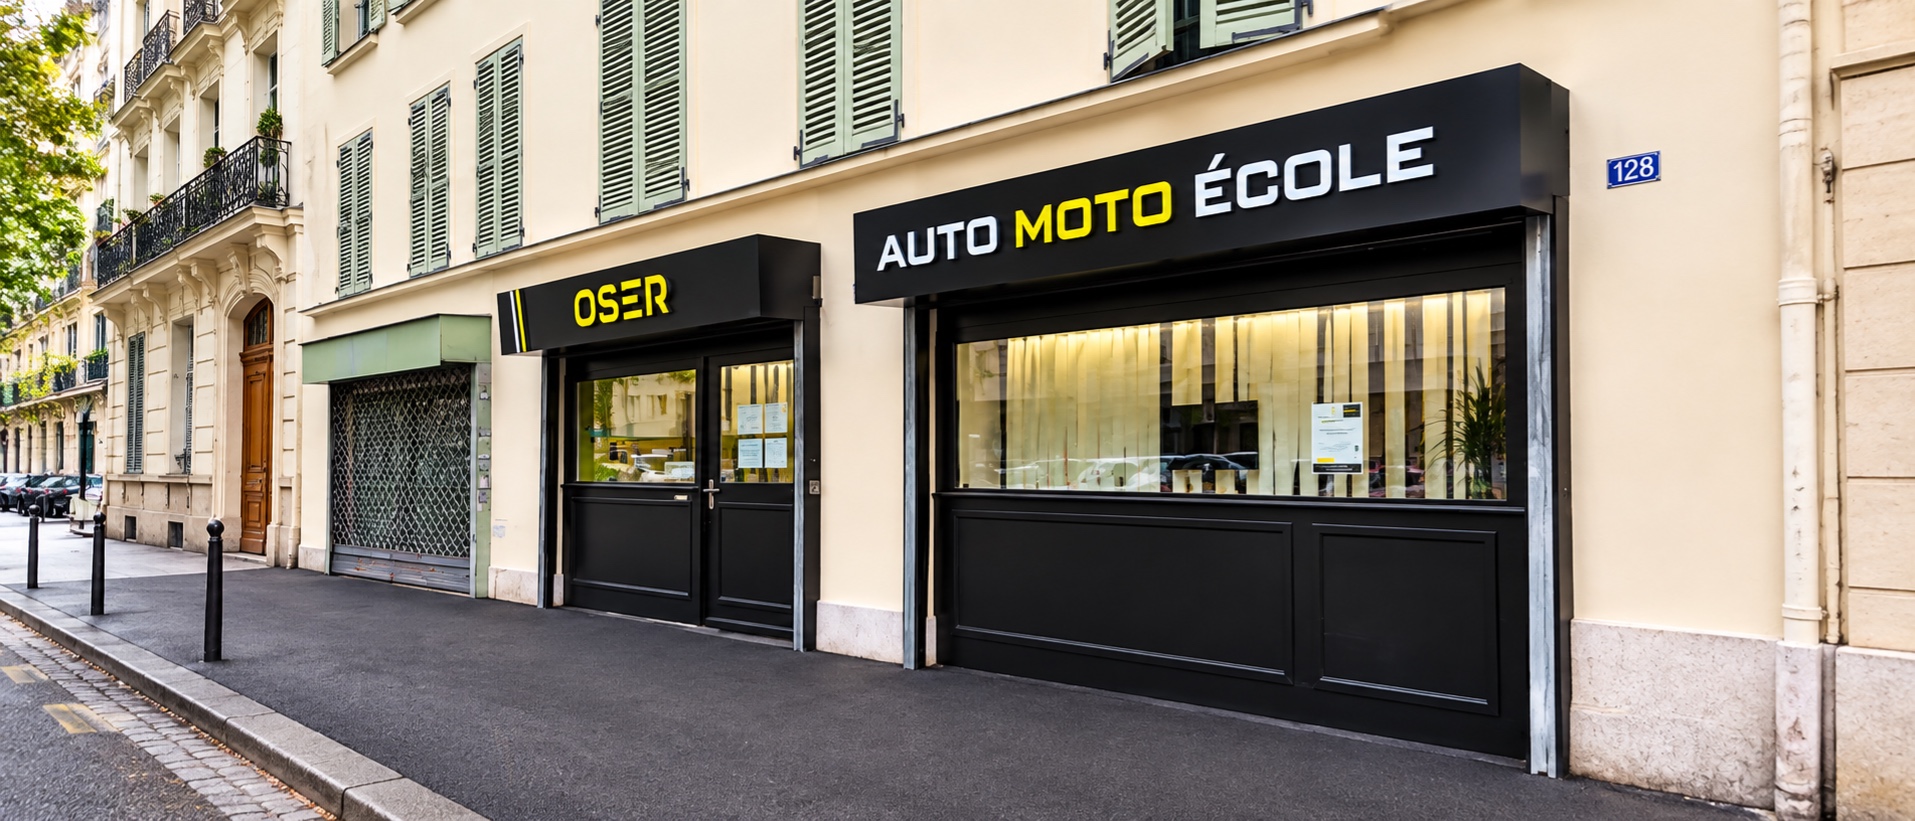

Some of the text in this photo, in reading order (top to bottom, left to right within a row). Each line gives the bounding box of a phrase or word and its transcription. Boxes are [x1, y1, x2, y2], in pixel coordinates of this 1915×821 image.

[1613, 156, 1655, 182] 128
[877, 126, 1434, 271] AUTO MOTO ÉCOLE
[574, 274, 670, 328] OSER
